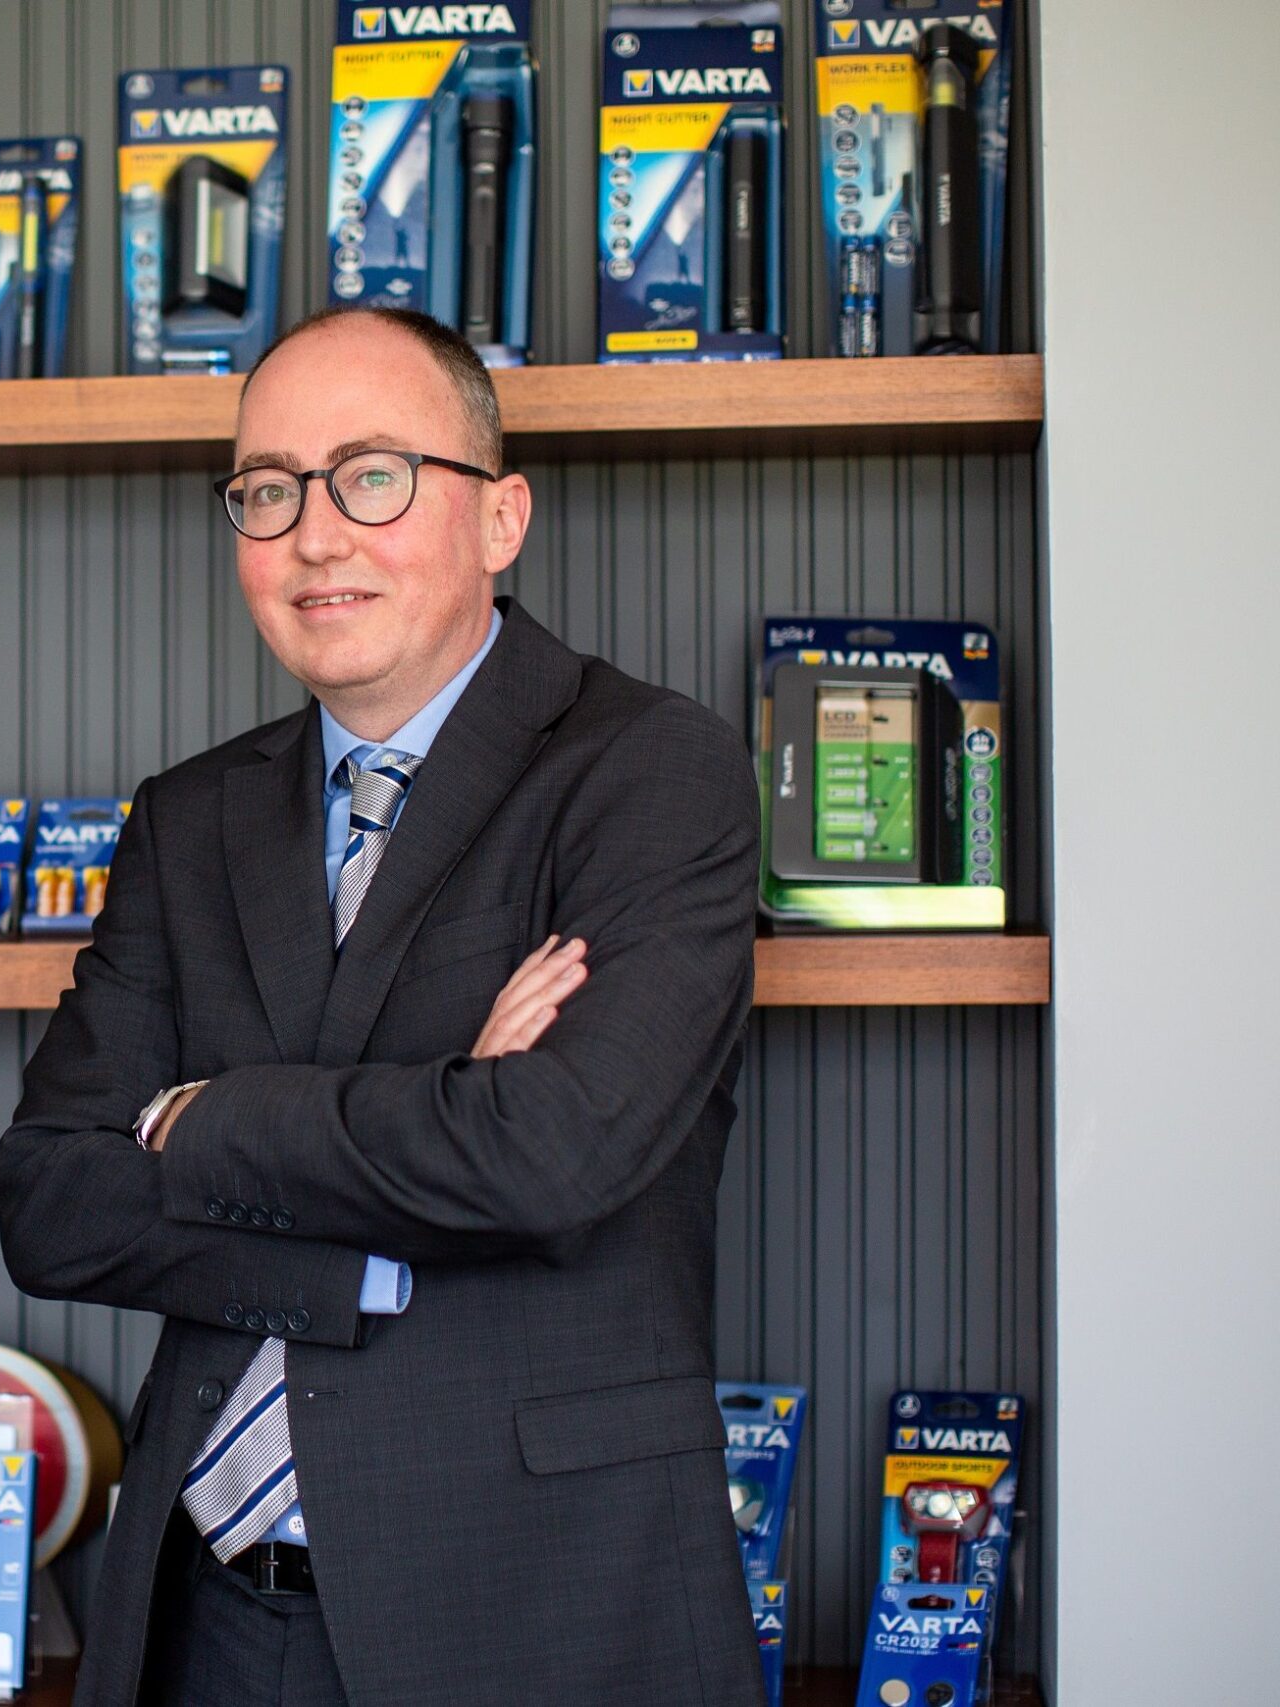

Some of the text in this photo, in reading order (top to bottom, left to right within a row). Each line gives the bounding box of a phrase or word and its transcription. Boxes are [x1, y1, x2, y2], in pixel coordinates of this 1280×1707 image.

[389, 5, 516, 35] VARTA
[655, 67, 771, 95] VARTA
[162, 105, 278, 135] VARTA
[824, 711, 857, 722] LCD
[922, 1427, 1012, 1453] VARTA
[878, 1612, 982, 1635] VARTA
[875, 1633, 940, 1649] CR2032
